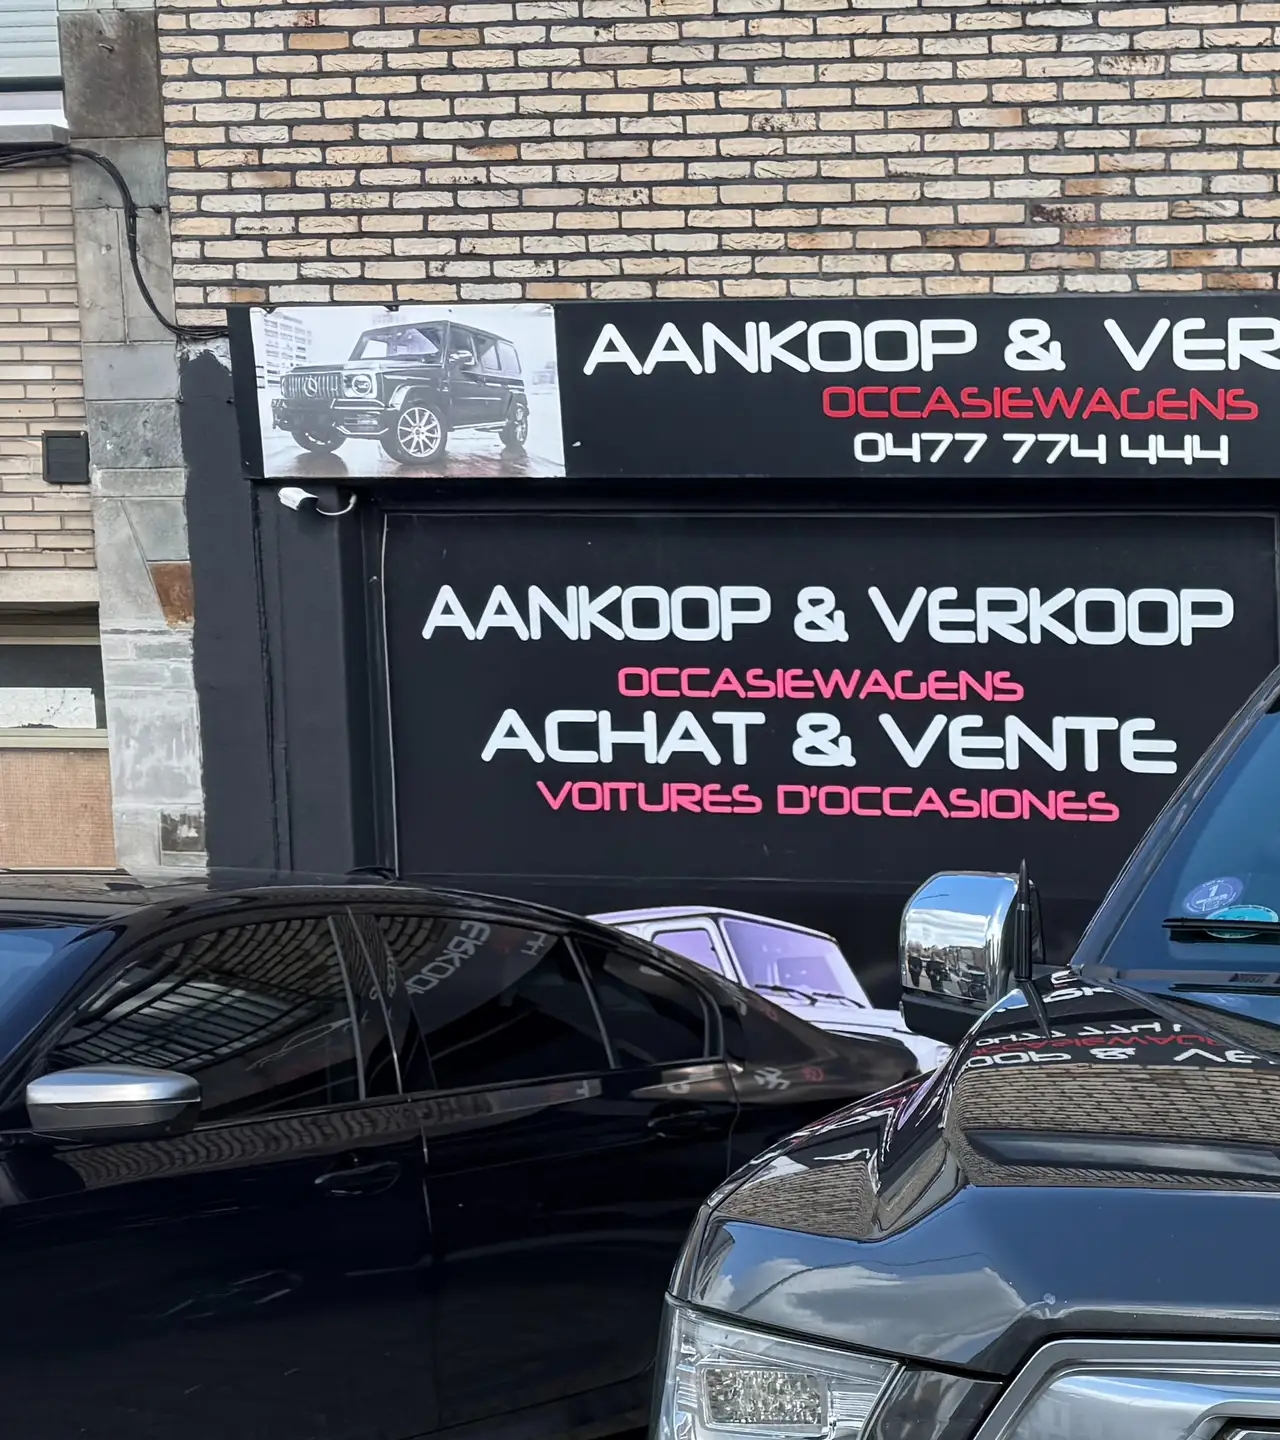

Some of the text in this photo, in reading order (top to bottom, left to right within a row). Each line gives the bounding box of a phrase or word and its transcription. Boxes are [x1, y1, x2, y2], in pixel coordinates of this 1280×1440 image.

[582, 318, 978, 376] AANKOOP
[1003, 317, 1067, 372] &
[823, 386, 1259, 421] OCCASIEWAGENS
[853, 431, 1229, 466] 0477 774 444
[421, 584, 1235, 647] AANKOOP & VERKOOP
[618, 667, 1025, 702] OCCASIEWAGENS
[480, 708, 1178, 774] ACHAT & VENTE
[537, 781, 1120, 823] VOITURES D'OCCASIONES
